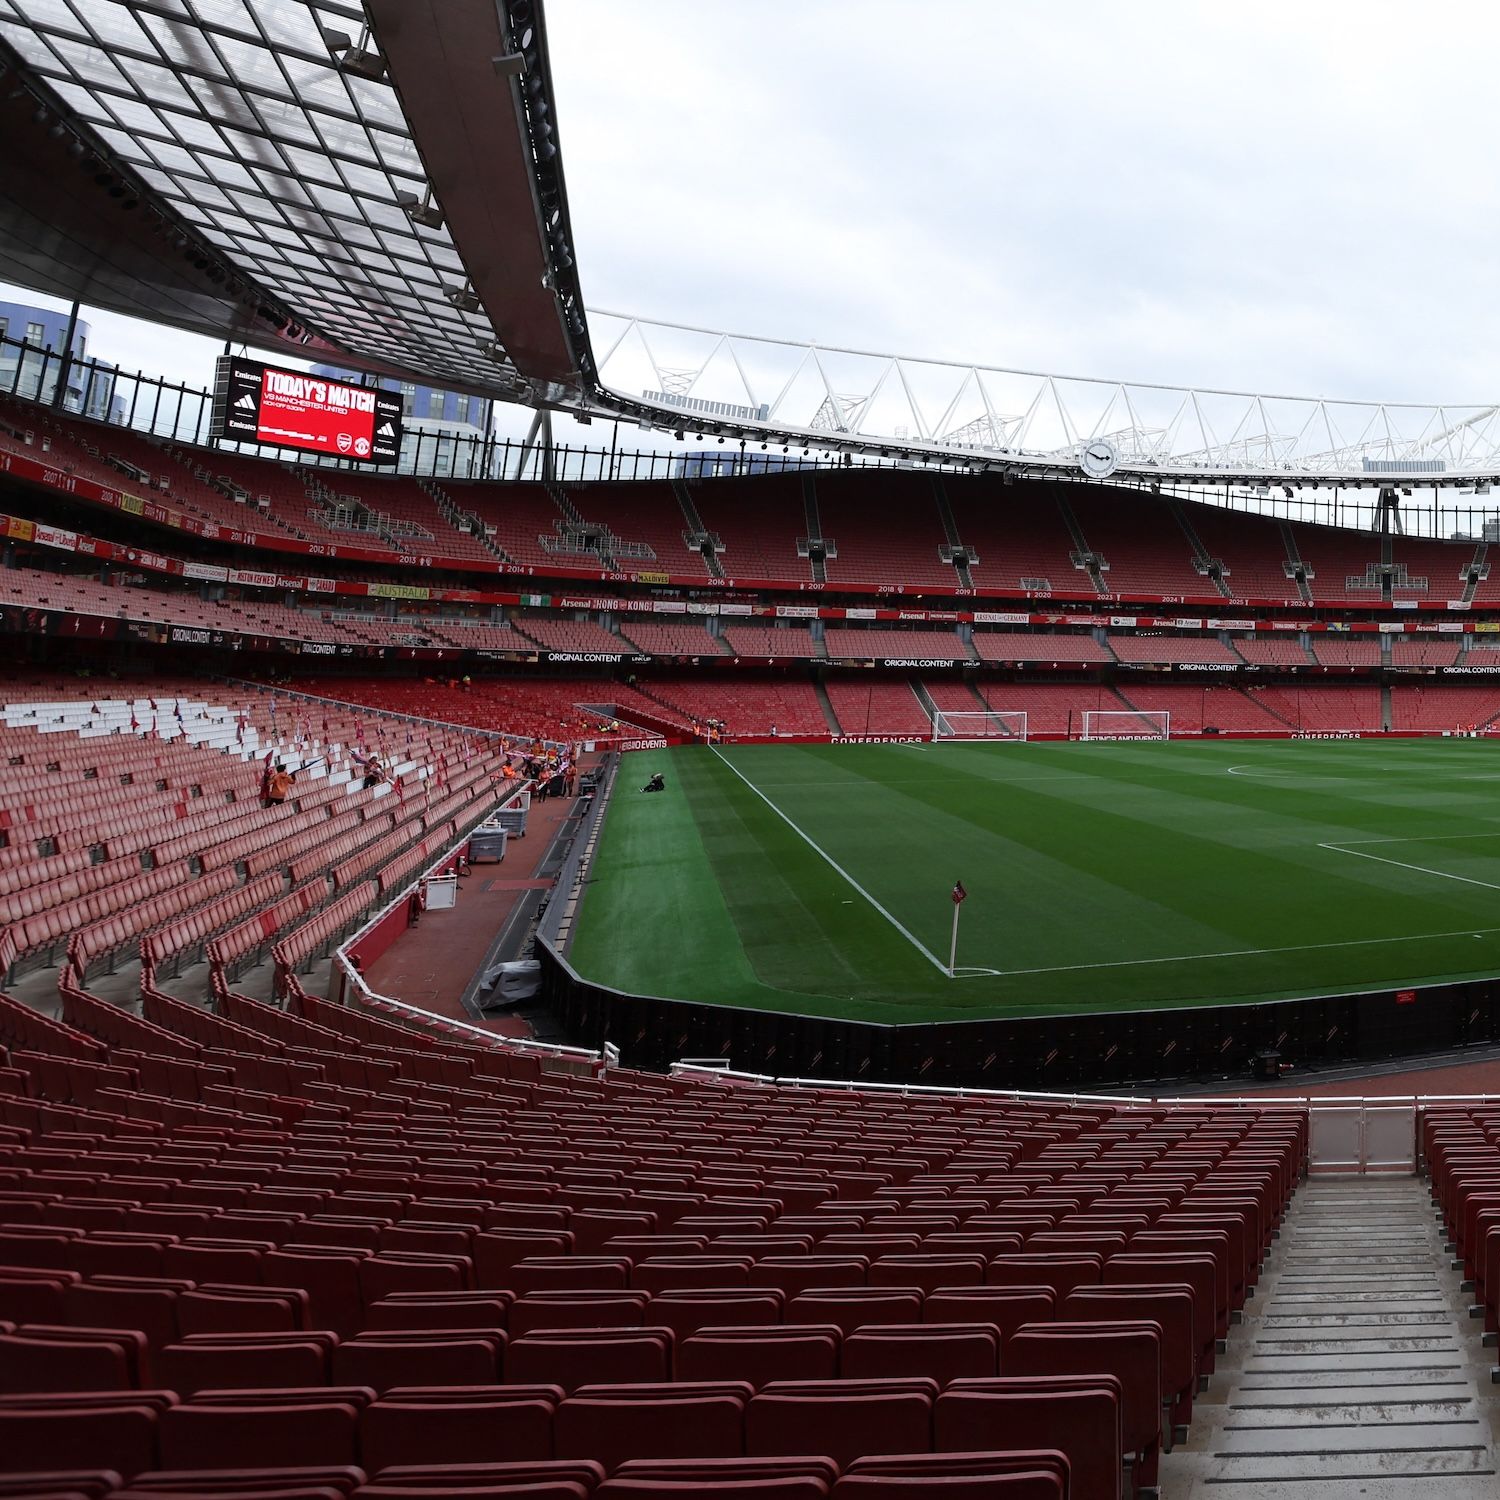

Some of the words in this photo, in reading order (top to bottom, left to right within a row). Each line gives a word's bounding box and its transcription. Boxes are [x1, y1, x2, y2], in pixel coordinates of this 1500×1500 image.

[234, 370, 262, 382] Emirates
[266, 371, 326, 402] TODAY'S
[328, 384, 376, 414] MATCH
[276, 395, 324, 410] MANCHESTER
[324, 404, 348, 414] UNITED
[378, 401, 400, 412] Emirates
[229, 420, 256, 431] Emirates
[373, 446, 396, 456] Emirates
[43, 470, 56, 485] 2007
[309, 545, 324, 554] 2012
[400, 555, 416, 564] 2013
[507, 566, 524, 574] 2014
[610, 572, 628, 581] 2015
[276, 577, 302, 588] Arsenal
[378, 586, 428, 599] AUSTRALIA
[560, 600, 590, 608] Arsenal
[598, 600, 618, 610] HONG
[628, 600, 649, 611] KONG
[899, 612, 925, 620] Arsenal
[976, 614, 998, 622] ARSENAL
[548, 653, 584, 662] ORIGINAL
[584, 654, 622, 662] CONTENT
[641, 740, 667, 749] EVENTS
